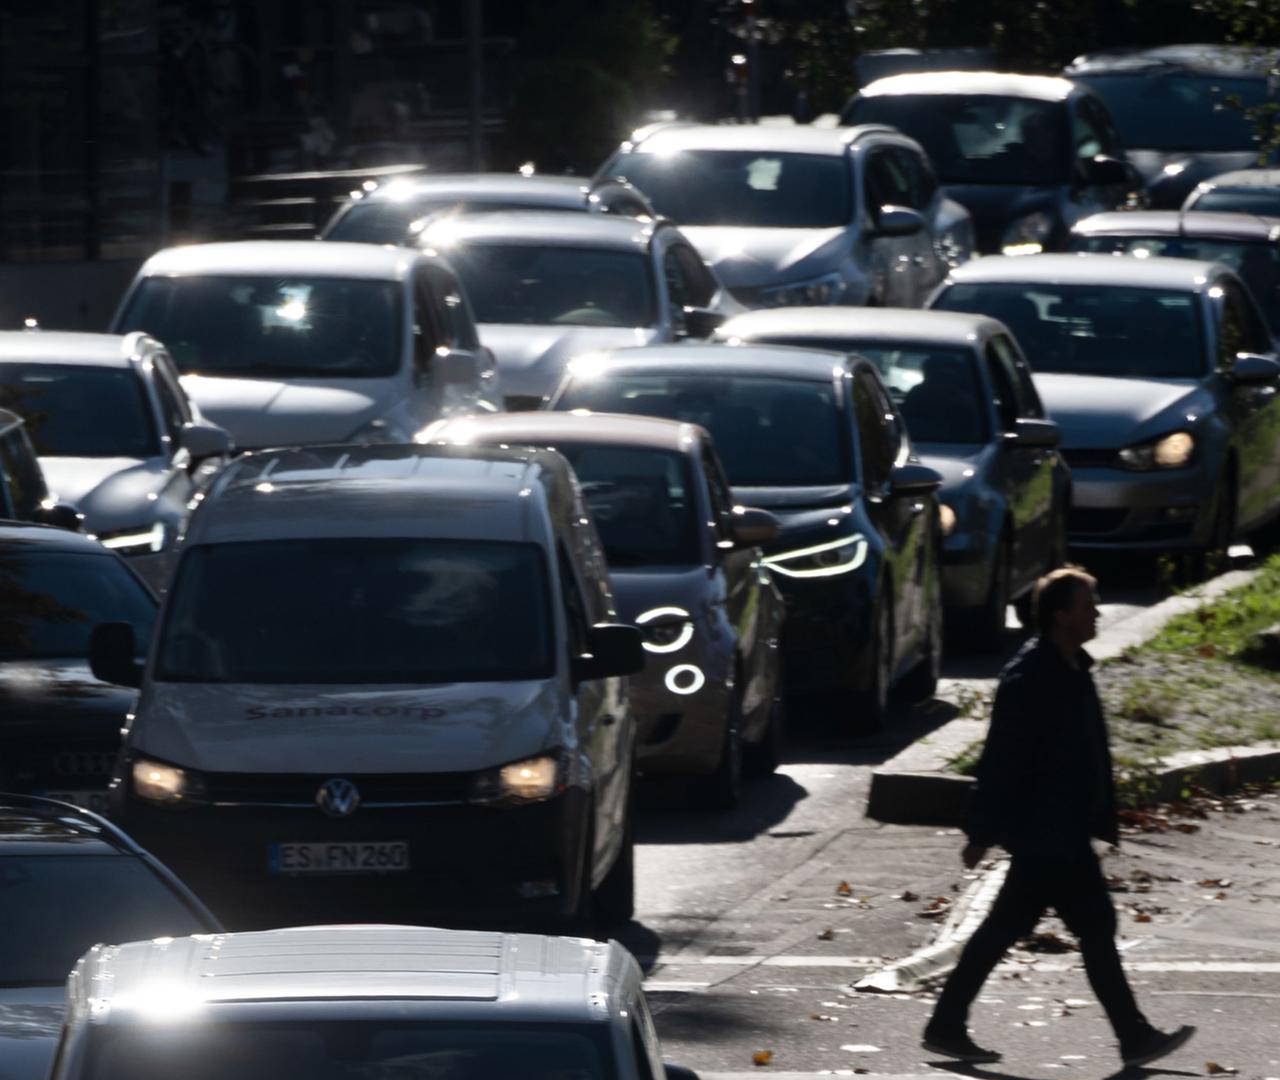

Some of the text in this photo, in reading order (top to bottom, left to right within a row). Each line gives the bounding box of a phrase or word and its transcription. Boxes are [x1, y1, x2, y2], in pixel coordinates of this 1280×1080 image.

[246, 704, 448, 721] Sanacorp
[282, 843, 405, 868] ES FN 260
